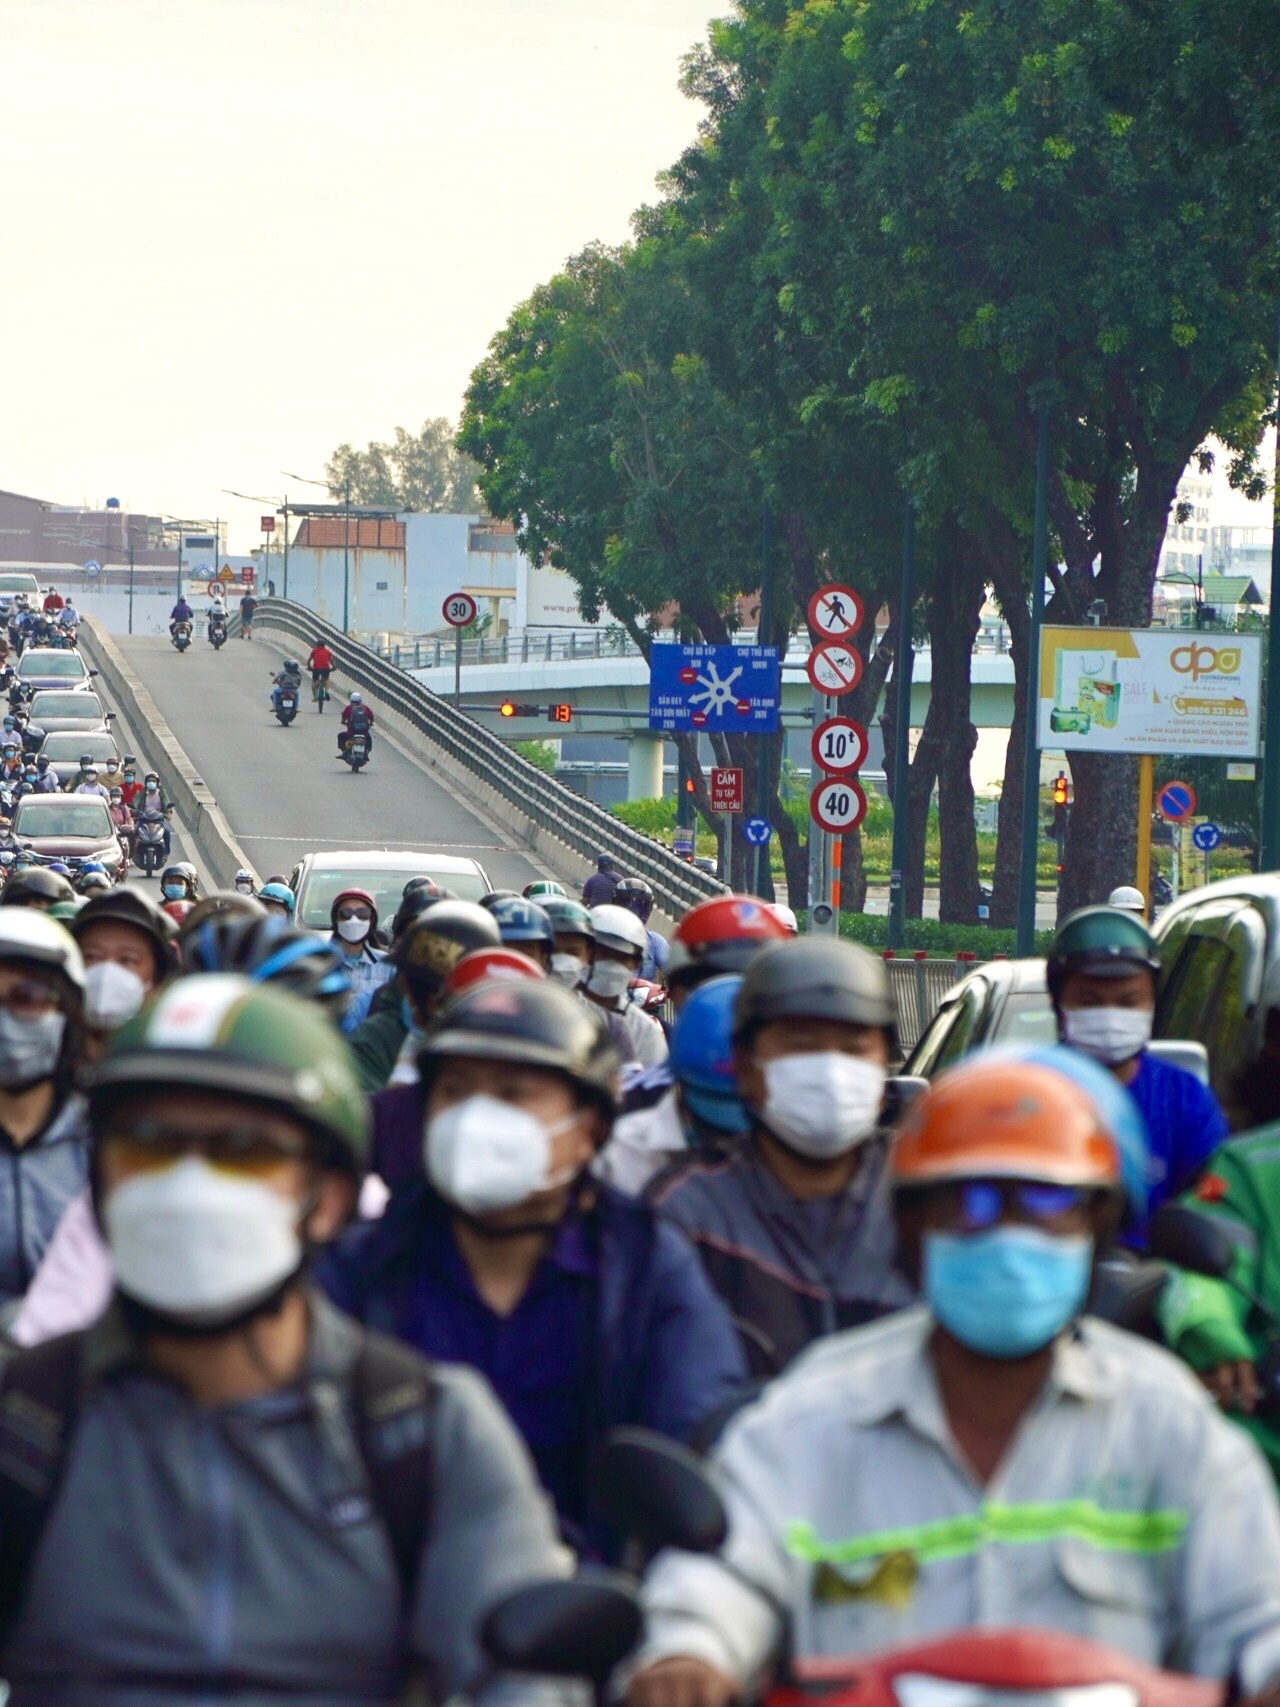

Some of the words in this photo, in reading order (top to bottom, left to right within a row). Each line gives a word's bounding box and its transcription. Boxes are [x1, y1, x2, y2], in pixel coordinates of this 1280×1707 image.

[451, 602, 466, 617] 30
[737, 648, 748, 658] CHỢ
[555, 705, 569, 722] 13
[1187, 706, 1210, 714] 0906
[1212, 707, 1227, 715] 331
[1228, 707, 1246, 716] 246
[717, 769, 736, 785] CẤM
[825, 792, 850, 817] 40
